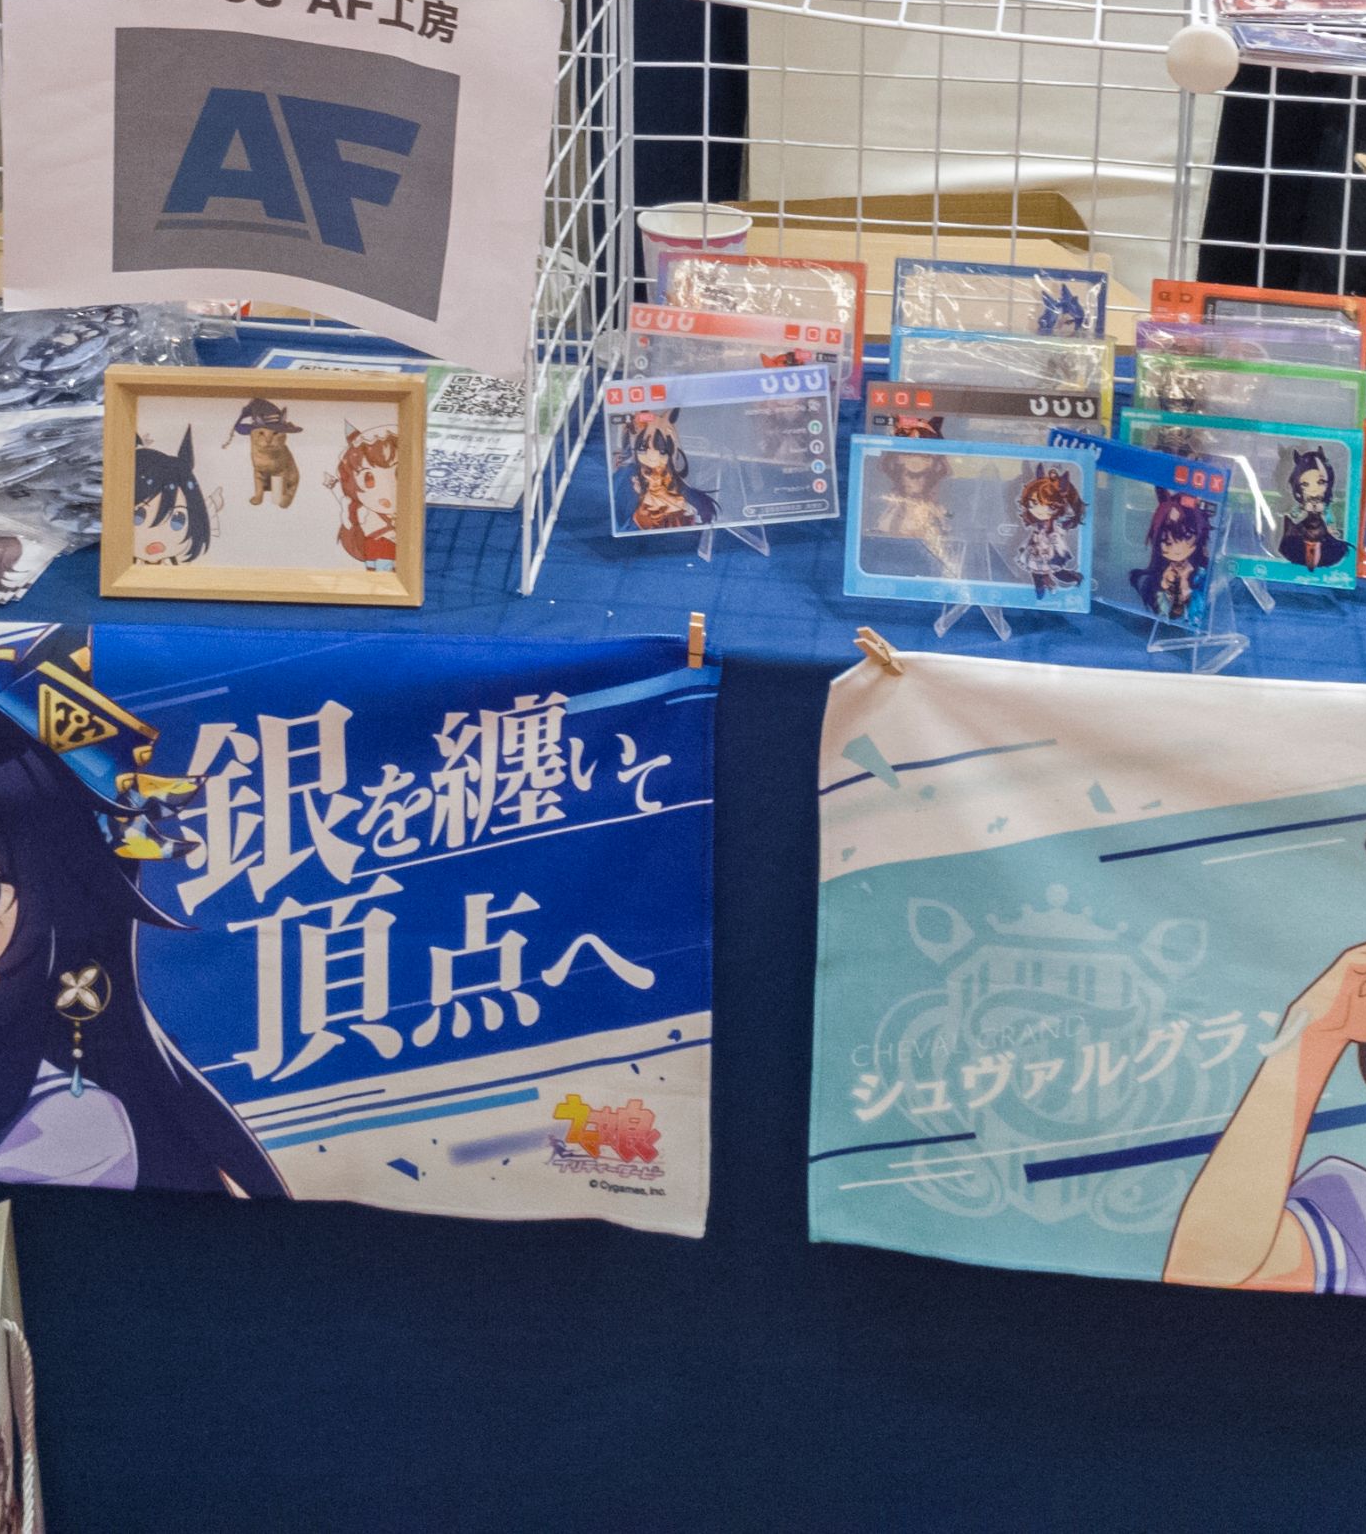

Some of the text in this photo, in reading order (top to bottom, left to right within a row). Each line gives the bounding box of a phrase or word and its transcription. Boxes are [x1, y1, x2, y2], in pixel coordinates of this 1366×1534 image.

[161, 86, 422, 255] AF
[176, 691, 672, 916] 銀を纏いて
[226, 873, 656, 1083] 頂点へ
[978, 1014, 1087, 1050] GRAND
[851, 1009, 1310, 1123] シュヴァルグラン
